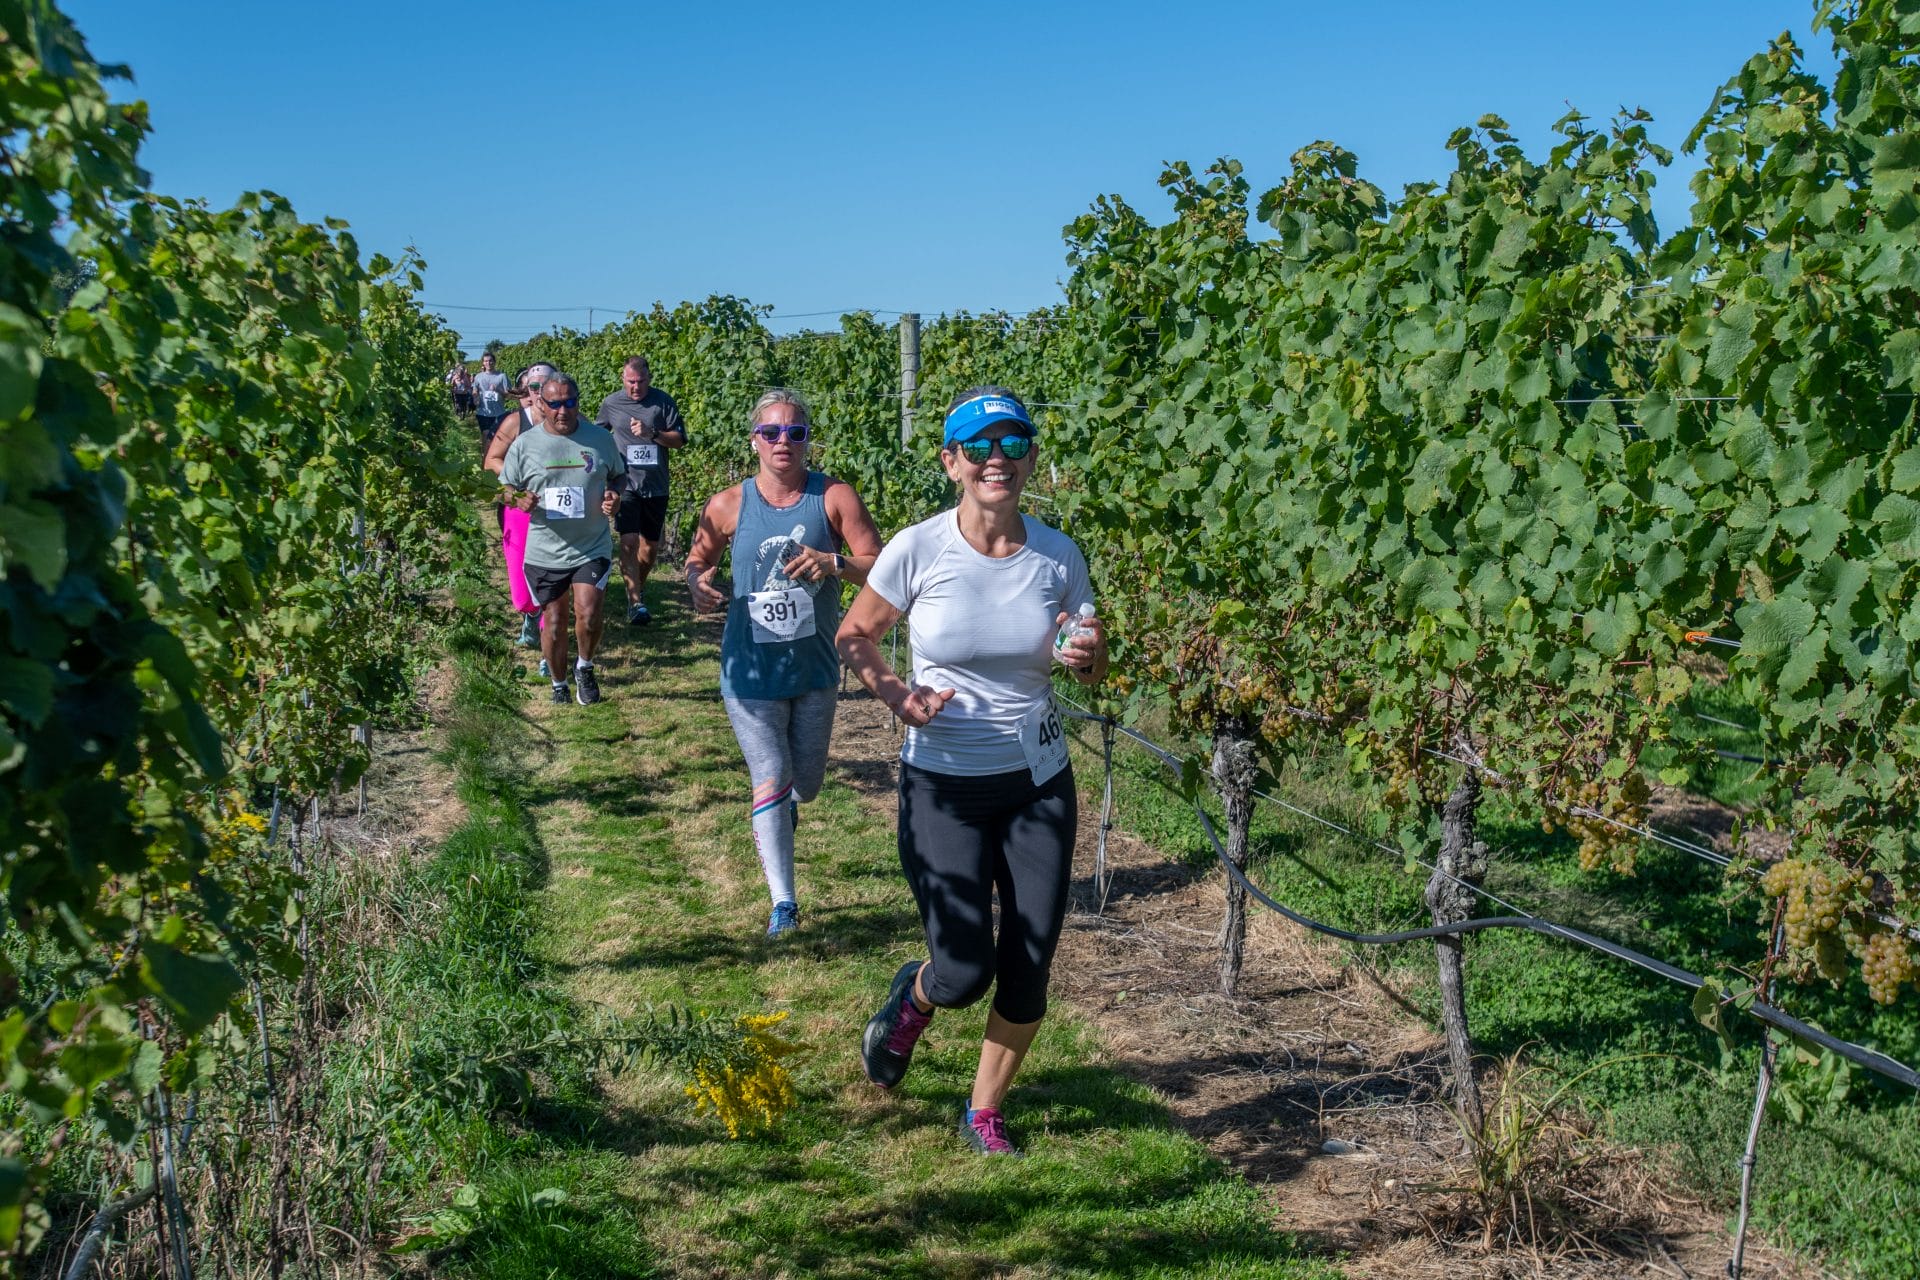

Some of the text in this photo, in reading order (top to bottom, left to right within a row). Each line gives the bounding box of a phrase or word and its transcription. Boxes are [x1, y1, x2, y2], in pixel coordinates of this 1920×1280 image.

[633, 450, 651, 460] 324
[556, 494, 572, 507] 78
[763, 600, 798, 622] 391
